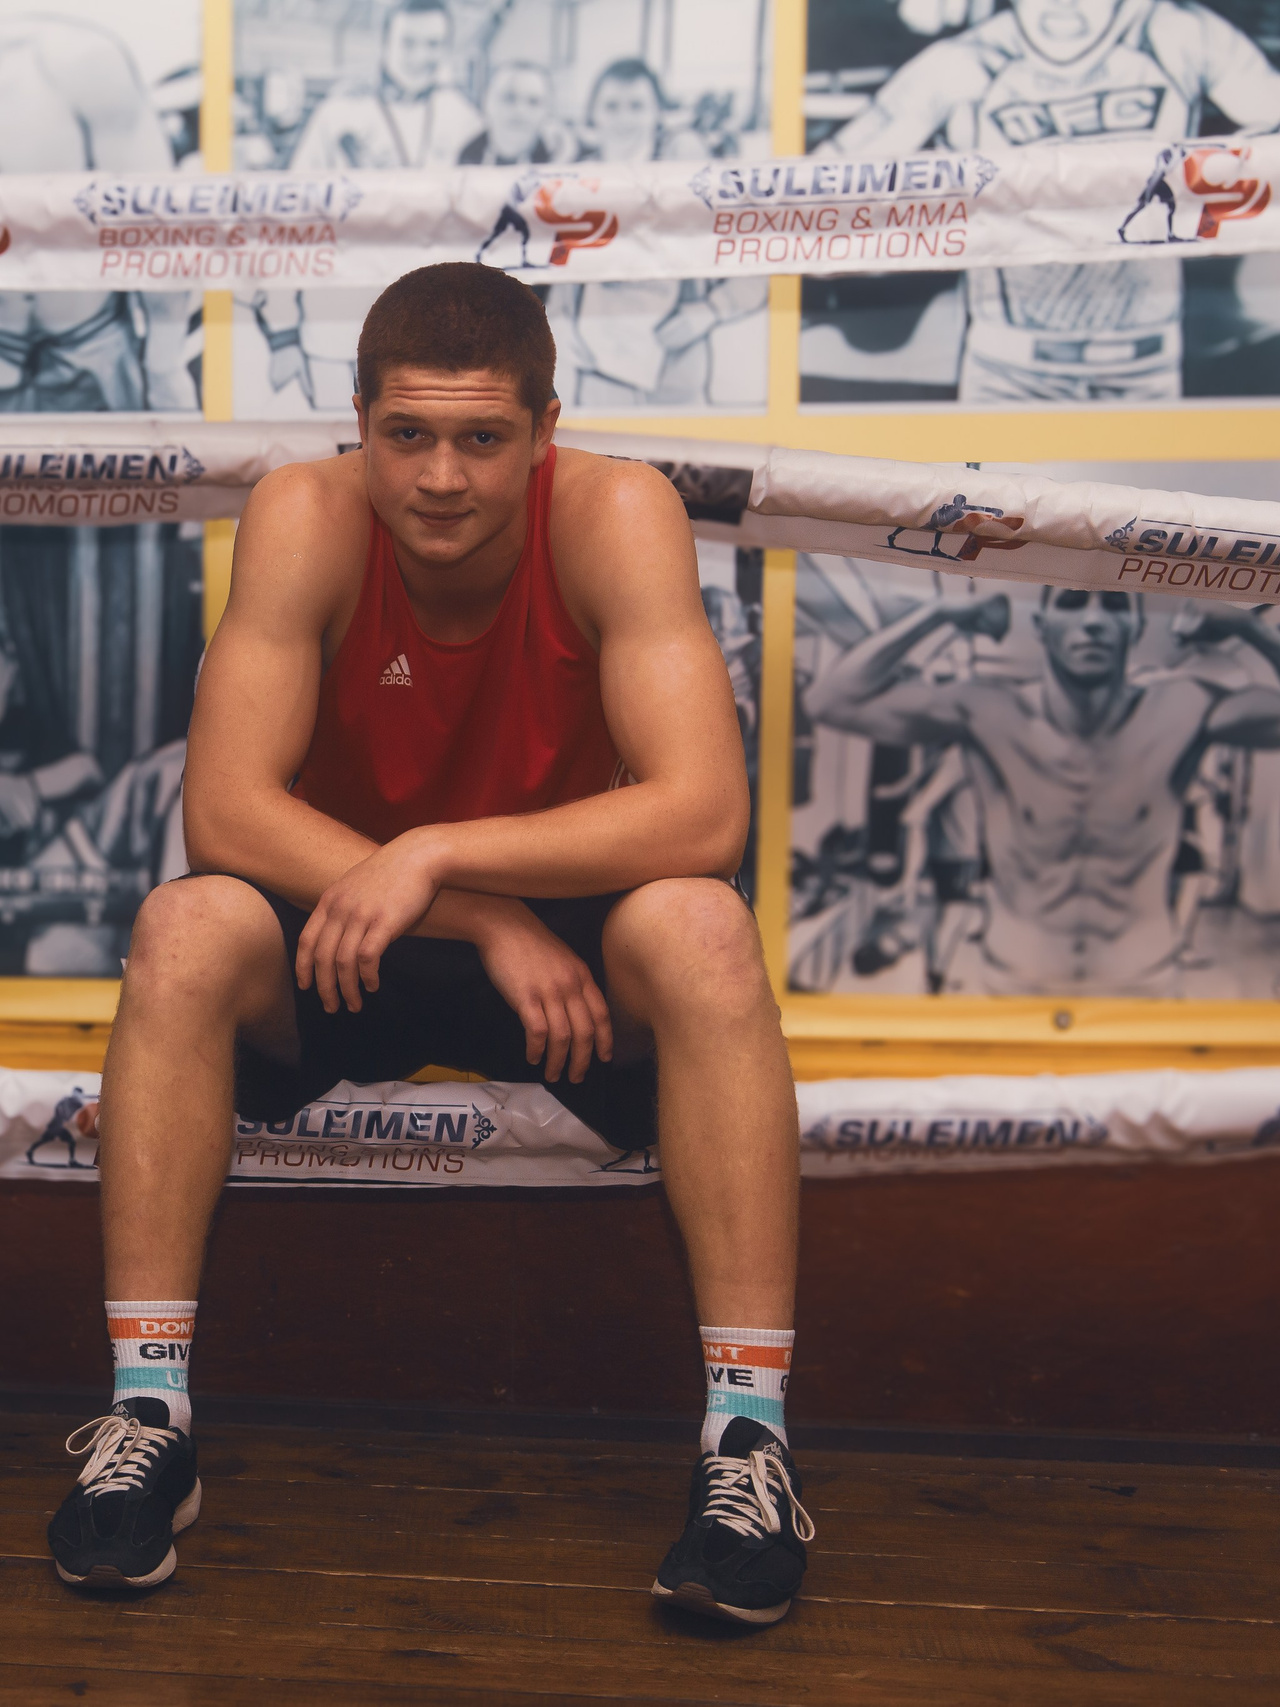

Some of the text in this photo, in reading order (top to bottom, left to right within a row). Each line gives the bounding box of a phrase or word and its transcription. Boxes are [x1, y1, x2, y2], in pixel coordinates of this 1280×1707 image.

[720, 160, 967, 199] SULEIMEN
[101, 183, 334, 215] SULEIMEN
[713, 201, 969, 235] BOXING & MMA
[99, 225, 336, 247] BOXING & MMA
[715, 229, 967, 264] PROMOTIONS
[100, 249, 336, 278] PROMOTIONS
[1134, 529, 1280, 566] SULEI
[836, 1119, 1082, 1148] SULEIMEN
